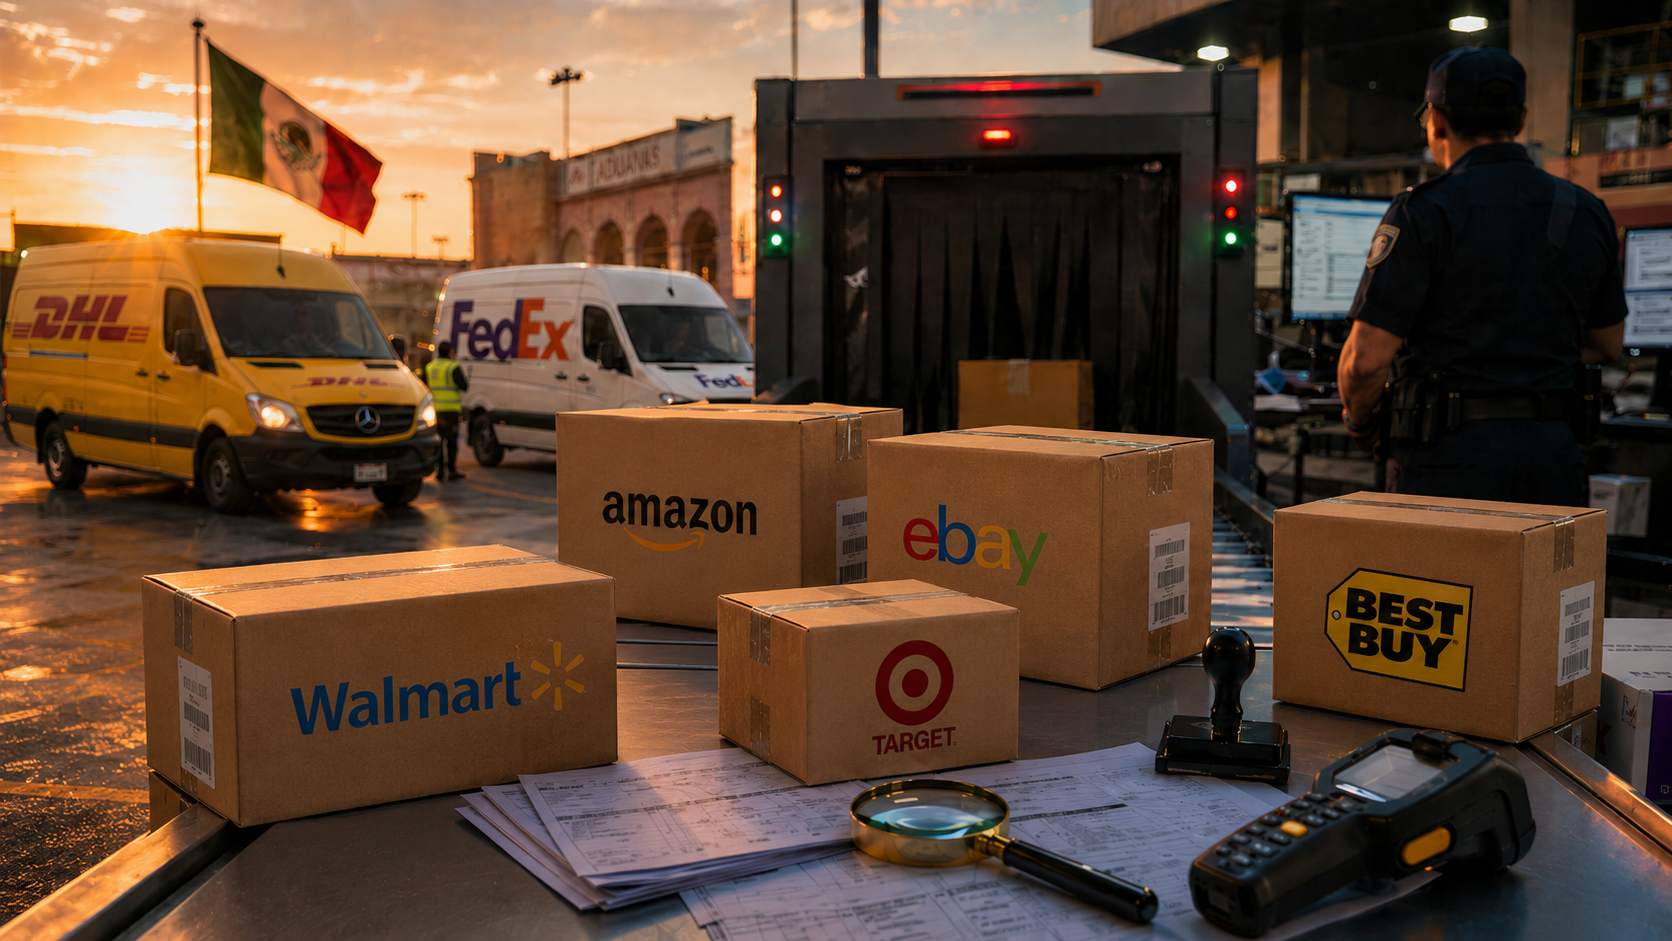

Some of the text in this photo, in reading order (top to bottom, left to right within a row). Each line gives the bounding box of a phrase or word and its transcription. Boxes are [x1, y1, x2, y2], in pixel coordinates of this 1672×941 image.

[30, 294, 130, 342] DHL
[450, 298, 574, 362] FedEx
[307, 377, 388, 386] DHL
[602, 491, 757, 536] amazon
[903, 504, 1048, 587] ebay
[1346, 586, 1463, 636] BEST
[290, 661, 522, 736] Walmart
[872, 726, 956, 755] TARGET
